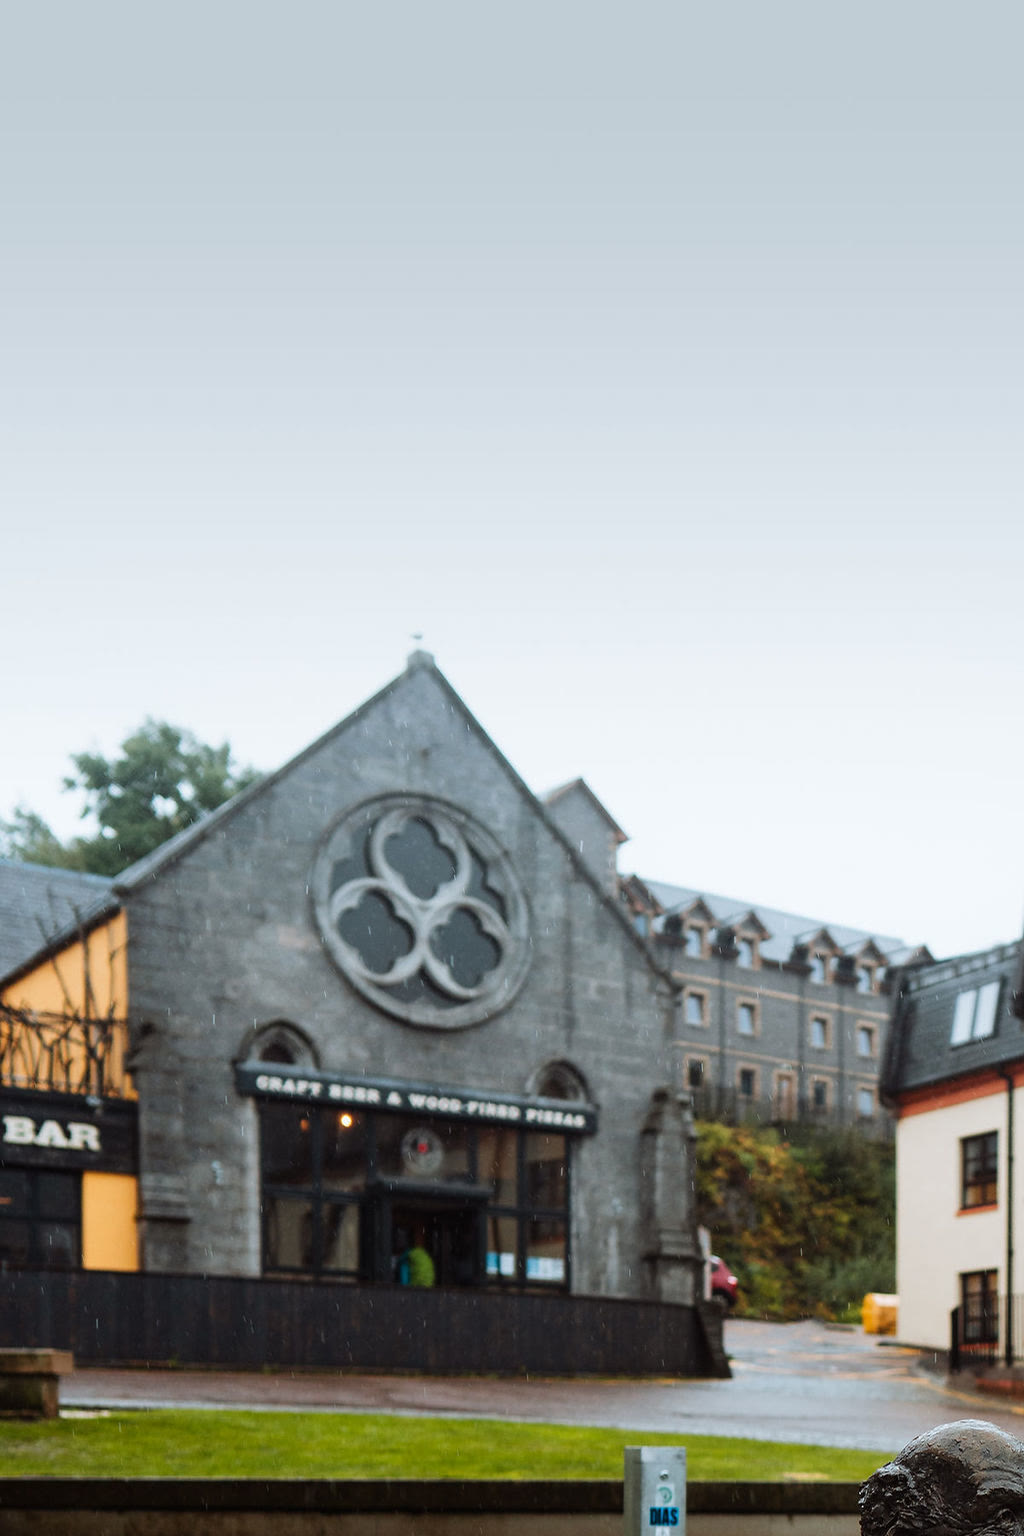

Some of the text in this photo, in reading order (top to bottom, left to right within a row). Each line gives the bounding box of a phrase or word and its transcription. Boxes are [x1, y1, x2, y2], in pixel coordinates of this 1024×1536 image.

[256, 1074, 323, 1097] CRAFT
[329, 1083, 380, 1105] BEER
[525, 1107, 586, 1128] PIZZAS
[3, 1115, 101, 1152] BAR
[650, 1507, 678, 1526] DIAS
